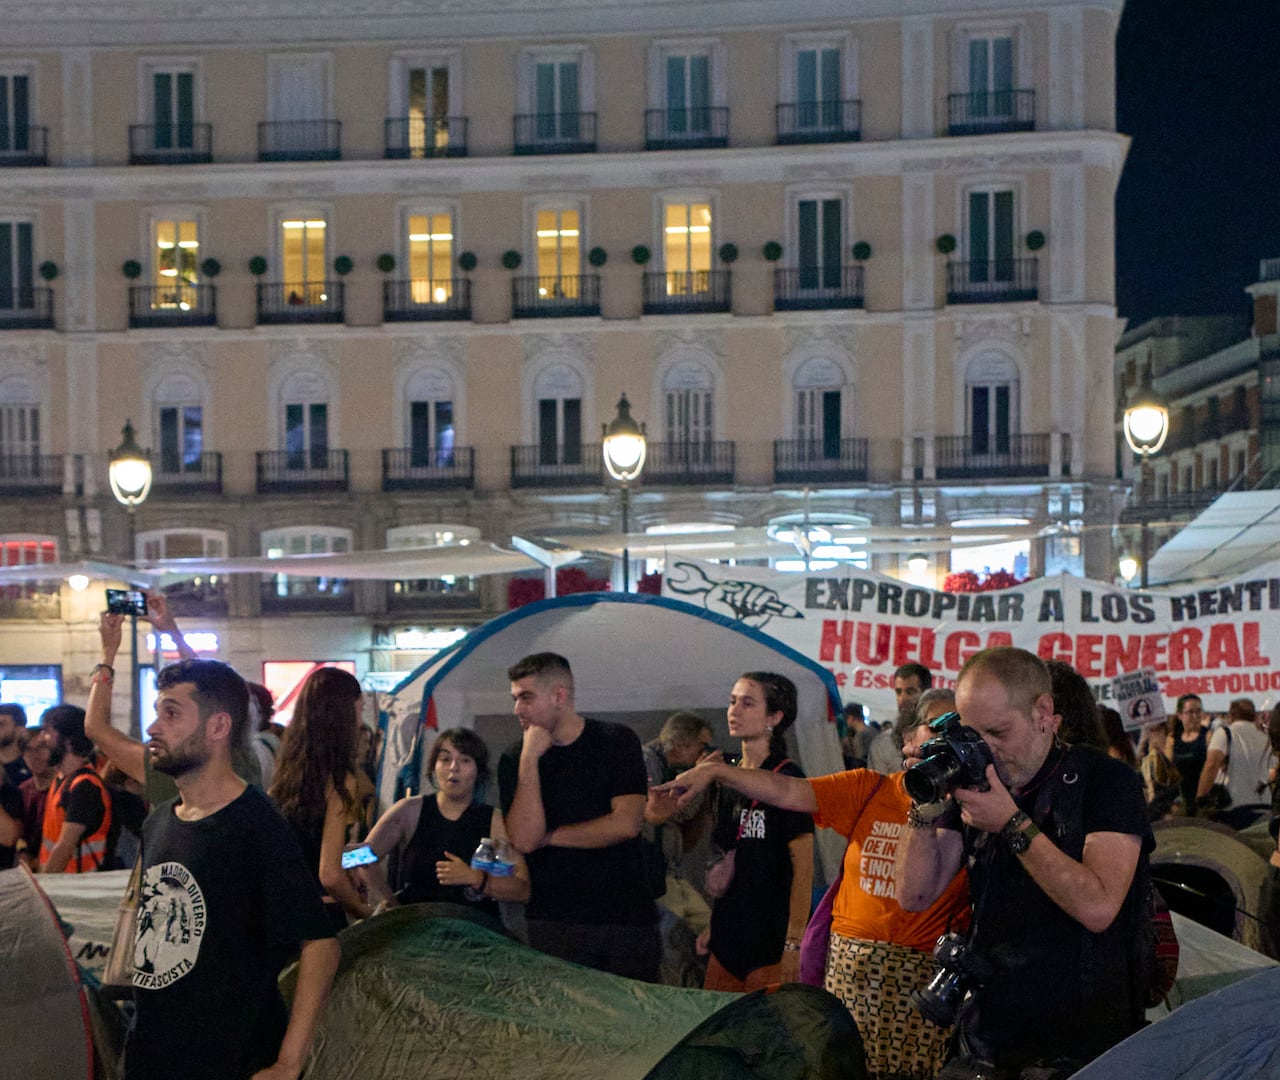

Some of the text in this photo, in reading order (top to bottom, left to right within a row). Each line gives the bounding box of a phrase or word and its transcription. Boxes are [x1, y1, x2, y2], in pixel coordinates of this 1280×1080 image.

[805, 577, 1024, 622] EXPROPIAR
[1037, 589, 1064, 622] A
[1081, 590, 1156, 624] LOS
[1038, 622, 1270, 678] GENERAL
[864, 838, 882, 854] DE
[860, 857, 869, 875] E
[160, 863, 205, 937] MADRID DIVERSO
[133, 957, 193, 988] TIFASCISTA
